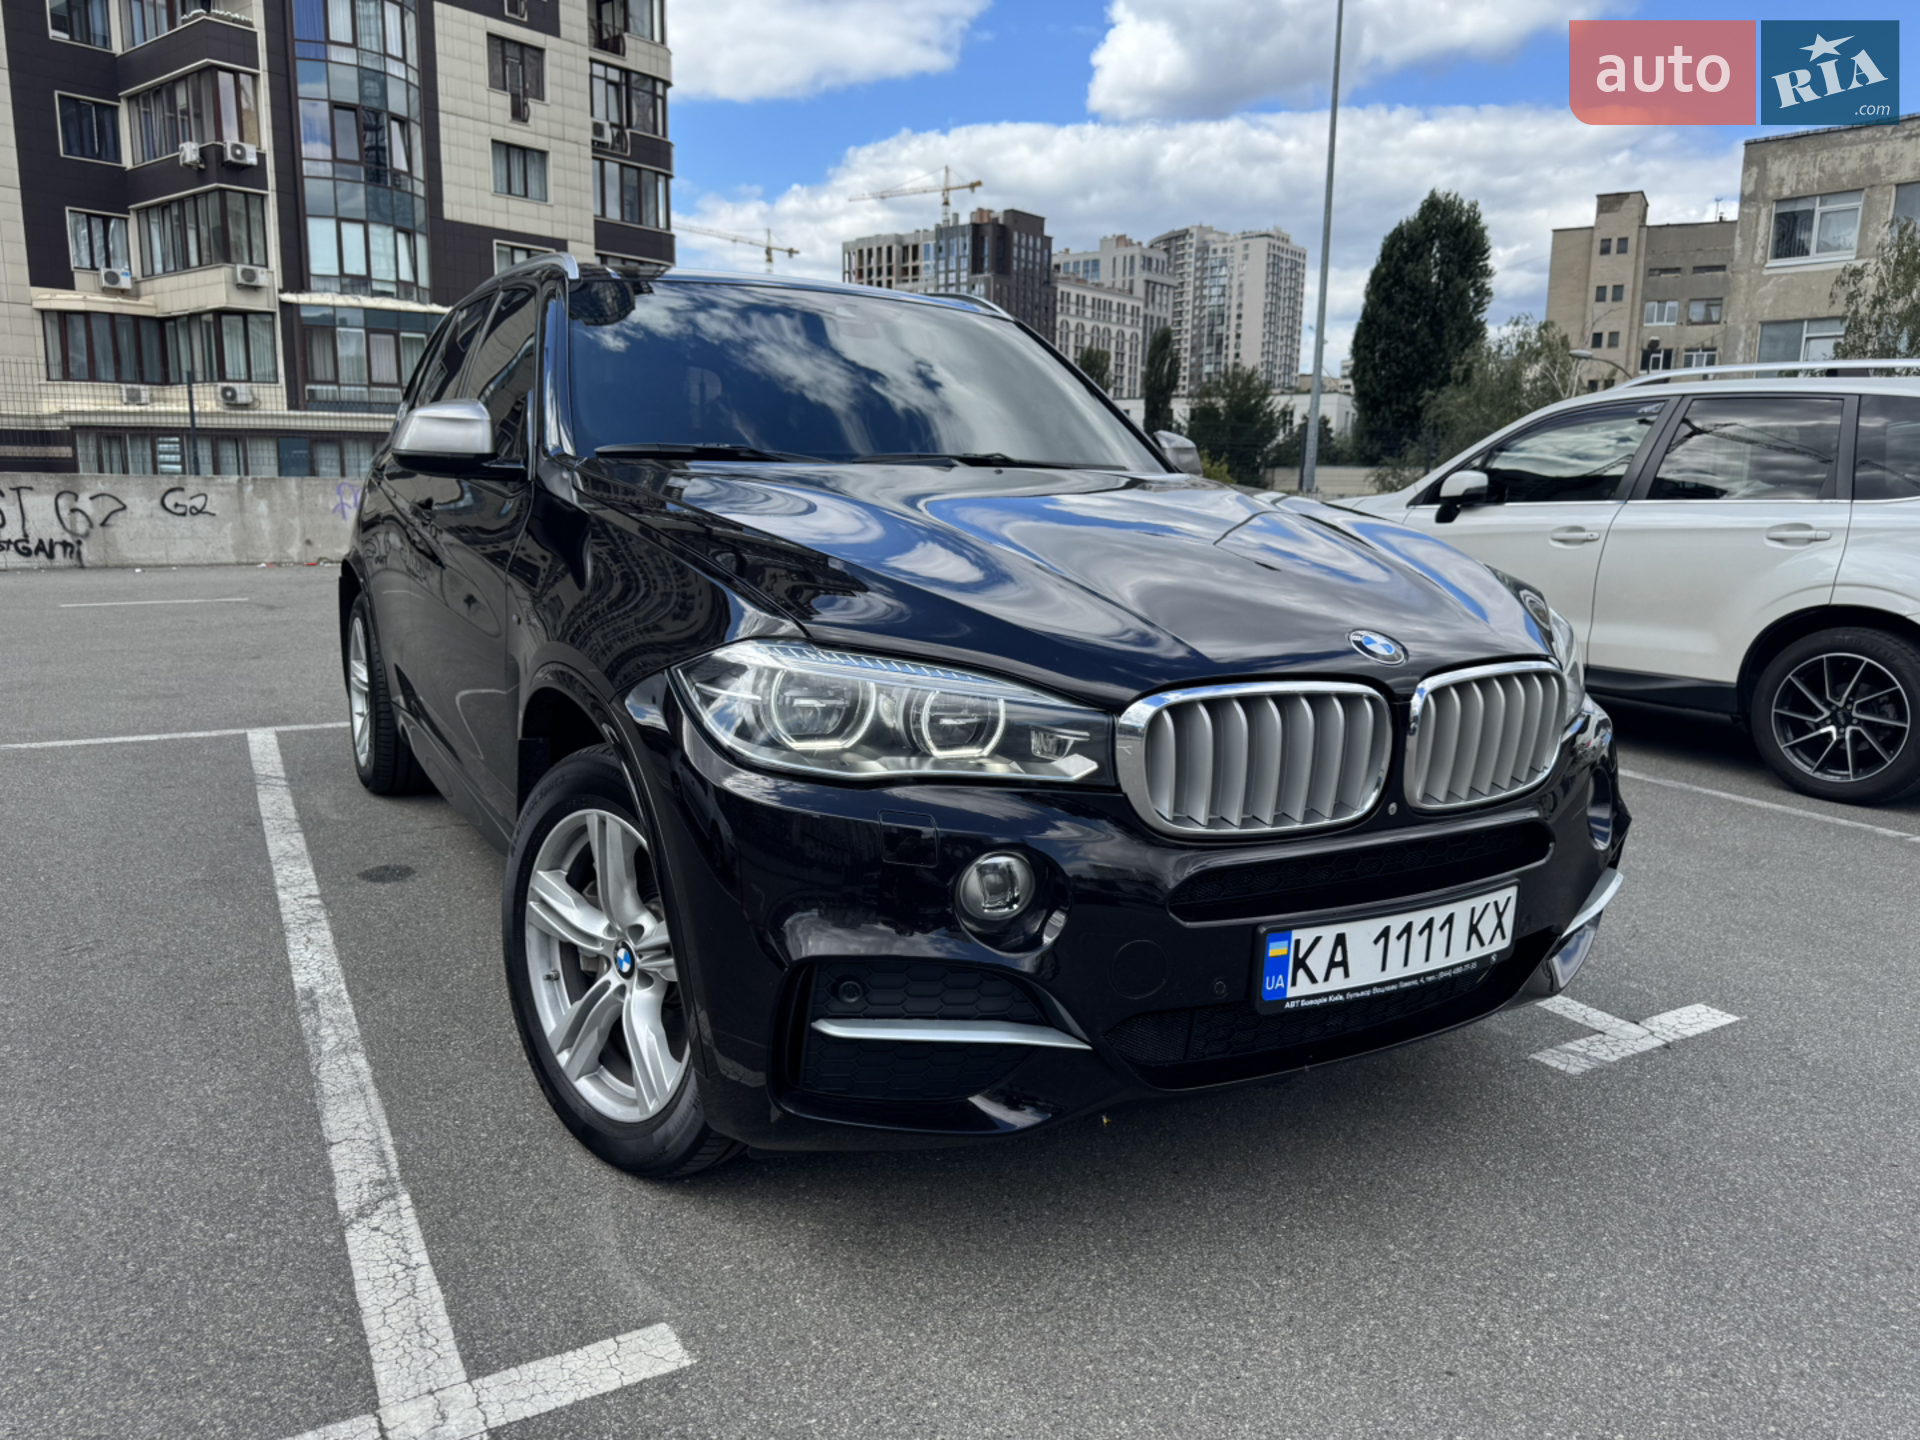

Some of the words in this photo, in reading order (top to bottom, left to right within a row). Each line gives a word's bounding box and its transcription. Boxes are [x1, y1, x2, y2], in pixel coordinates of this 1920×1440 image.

[160, 486, 217, 517] G2
[1290, 932, 1350, 988] KA
[1373, 912, 1455, 972] 1111
[1466, 895, 1512, 952] KX
[1265, 974, 1285, 990] UA
